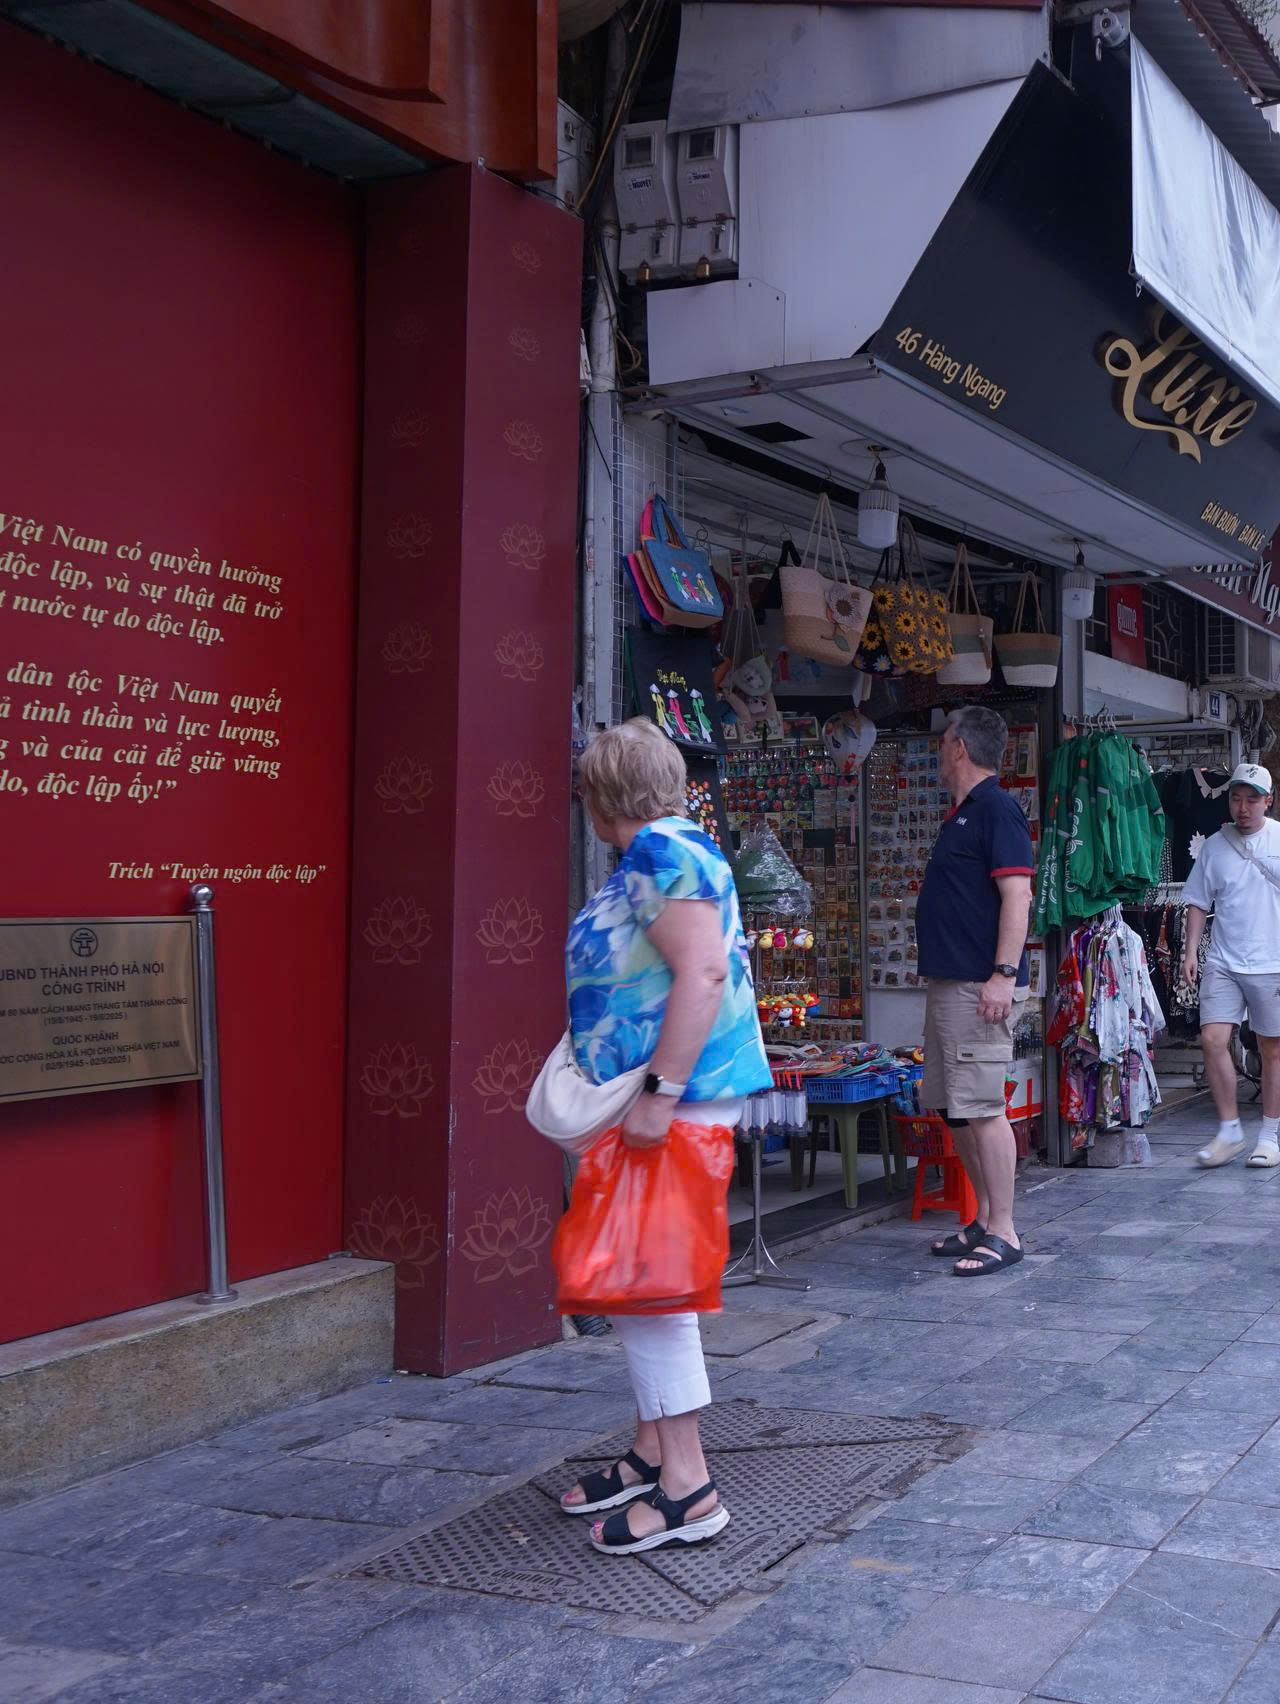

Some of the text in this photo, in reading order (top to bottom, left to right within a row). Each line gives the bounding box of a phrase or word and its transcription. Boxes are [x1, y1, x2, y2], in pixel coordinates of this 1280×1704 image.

[895, 326, 1007, 411] 46 Hàng Ngang
[1104, 300, 1259, 465] Luxe
[1200, 501, 1221, 525] BÁN
[1216, 511, 1241, 537] BUÔN
[1238, 523, 1257, 547] BÁN
[0, 513, 283, 595] Việt Nam có quyền hưởng
[0, 551, 284, 620] độc lập, và sự thật đã trở
[12, 590, 76, 619] nước
[82, 601, 109, 629] tự
[114, 606, 141, 629] do
[146, 613, 184, 640] độc
[189, 621, 225, 646] lập.
[6, 661, 283, 714] dân tộc Việt Nam quyết
[22, 699, 72, 725] tinh
[81, 701, 134, 730] thần
[144, 712, 169, 733] và
[176, 715, 210, 741] lực
[218, 719, 281, 747] lượng,
[21, 735, 49, 759] và
[60, 738, 103, 762] của
[114, 743, 147, 765] cải
[156, 741, 182, 768] để
[189, 752, 226, 774] giữ
[233, 755, 282, 780] vững
[37, 772, 81, 800] độc
[85, 774, 122, 803] lập
[108, 861, 154, 880] Trích
[223, 864, 263, 884] ngôn
[265, 863, 292, 882] độc
[40, 965, 88, 979] THÀNH
[91, 962, 118, 977] PHỐ
[122, 961, 140, 975] HÀ
[143, 960, 164, 977] NỘI
[42, 978, 126, 997] CÔNG TRÌNH
